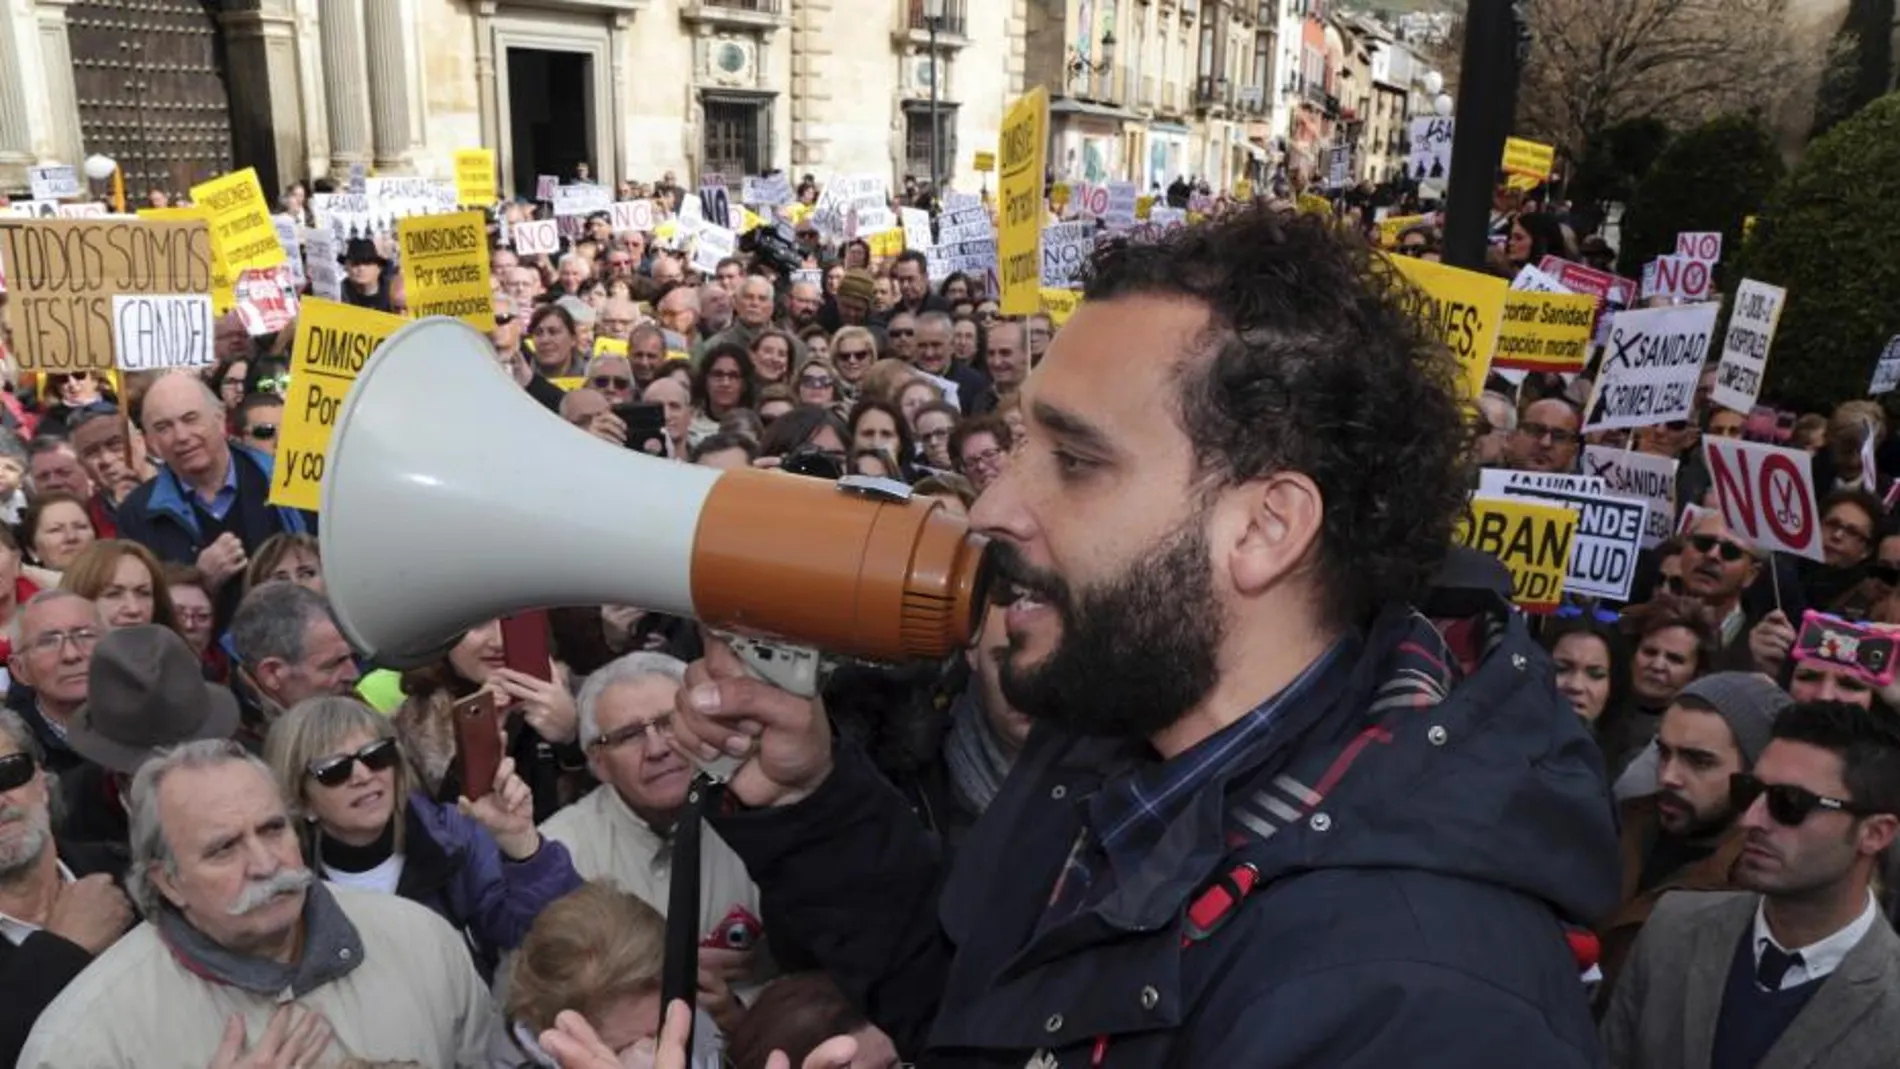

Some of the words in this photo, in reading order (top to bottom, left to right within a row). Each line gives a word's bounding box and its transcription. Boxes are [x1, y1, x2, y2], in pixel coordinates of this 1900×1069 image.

[615, 203, 650, 227] NO
[701, 188, 730, 229] NO
[1078, 182, 1109, 214] NO
[405, 224, 478, 255] DIMISIONES
[517, 223, 556, 251] NO
[1678, 234, 1718, 260] NO
[0, 224, 104, 292] TODOS
[106, 224, 209, 292] SOMOS
[415, 265, 436, 287] Por
[436, 262, 481, 283] recortes
[1655, 258, 1707, 294] NO
[119, 299, 214, 368] CANDEL
[1634, 332, 1707, 367] SANIDAD
[305, 384, 342, 425] Por
[1612, 382, 1655, 418] CRIMEN
[283, 448, 299, 487] y
[1709, 443, 1813, 550] NO
[1565, 542, 1628, 584] LUD
